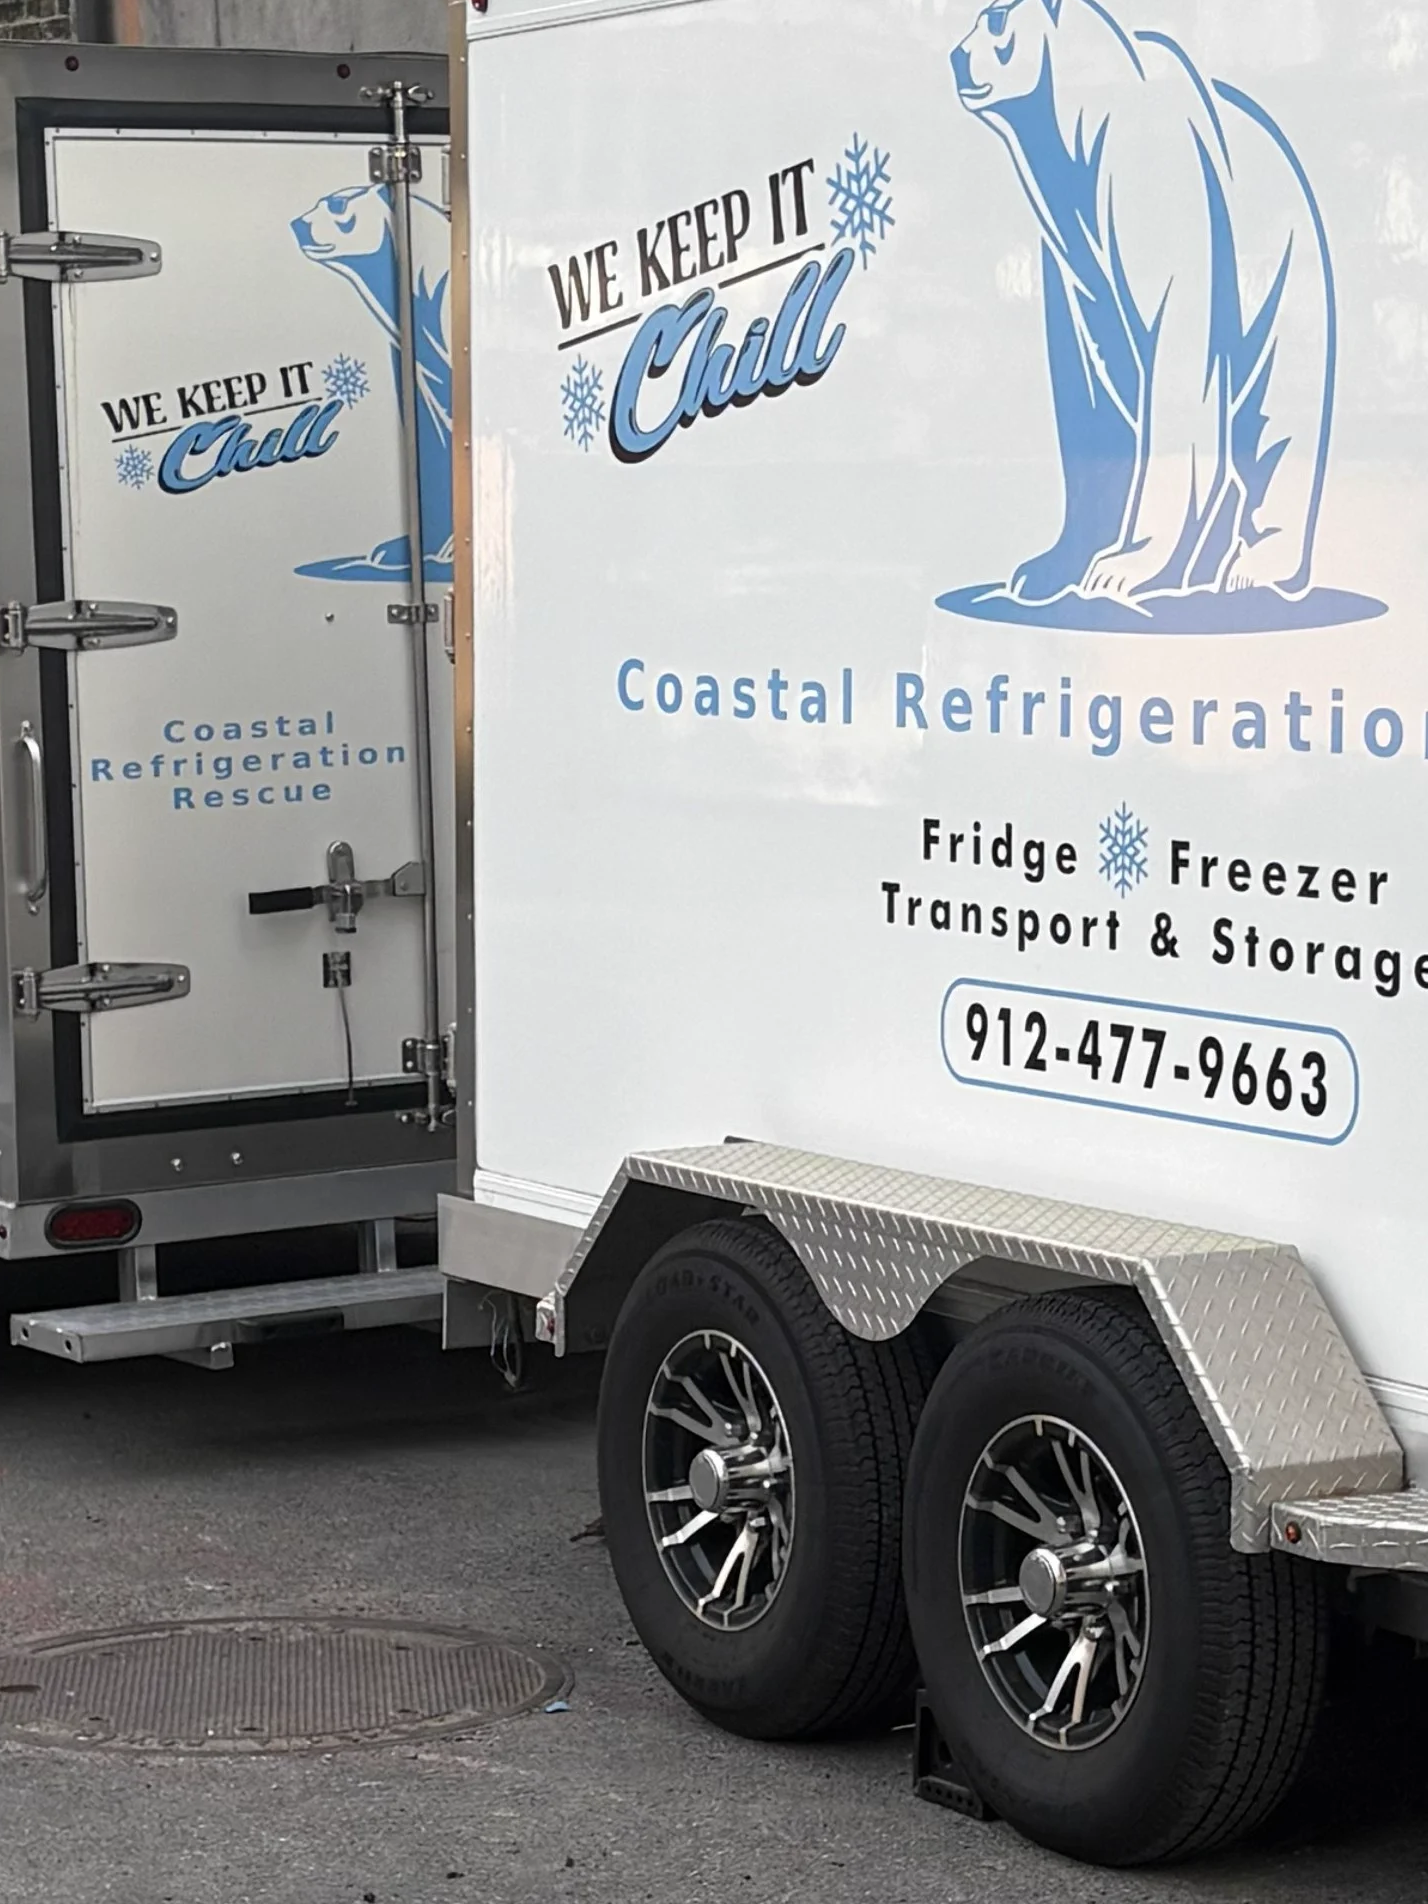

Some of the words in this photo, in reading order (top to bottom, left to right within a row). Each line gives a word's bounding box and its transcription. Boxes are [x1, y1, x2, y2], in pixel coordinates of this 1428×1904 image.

[547, 240, 624, 330] WE
[636, 189, 750, 297] KEEP
[768, 158, 815, 245] IT
[608, 246, 856, 465] Chill
[100, 392, 168, 433] WE
[176, 372, 267, 419] KEEP
[279, 361, 313, 398] IT
[157, 400, 345, 495] Chill
[163, 710, 333, 743] Coastal
[617, 658, 853, 725] Coastal
[91, 743, 405, 781] Refrigeration
[173, 783, 331, 810] Rescue
[923, 818, 1077, 883] Fridge
[1171, 839, 1388, 905] Freezer
[881, 881, 1120, 952] Transport
[1150, 912, 1180, 958] &
[963, 1002, 1331, 1120] 912-477-9663
